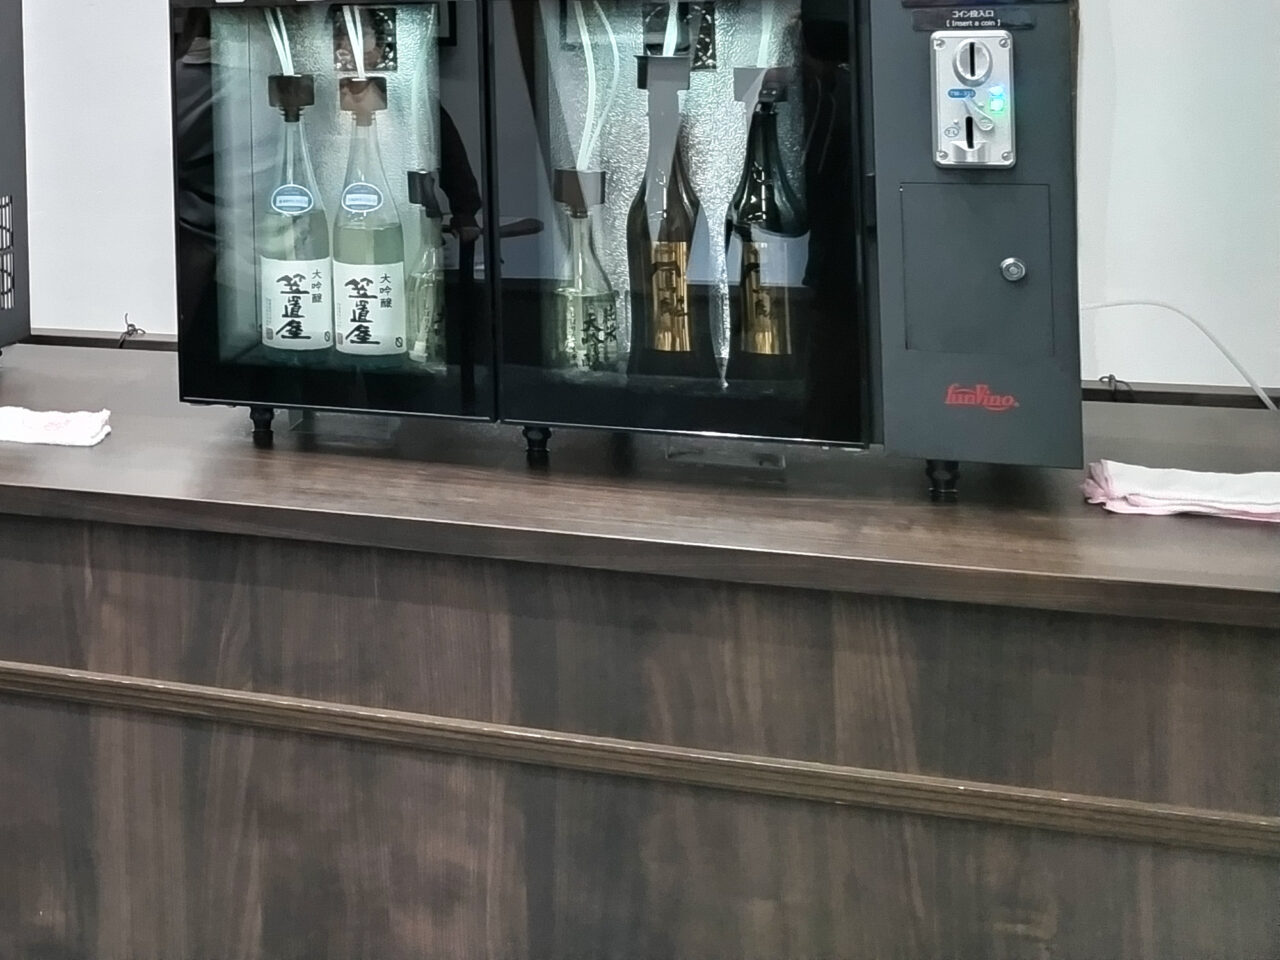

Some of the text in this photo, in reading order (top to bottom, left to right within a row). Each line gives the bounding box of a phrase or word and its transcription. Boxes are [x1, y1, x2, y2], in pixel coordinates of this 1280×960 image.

[276, 273, 312, 340] 笠置屋
[311, 269, 323, 304] 大吟醸
[344, 277, 381, 345] 笠置屋
[379, 273, 393, 309] 大吟醸
